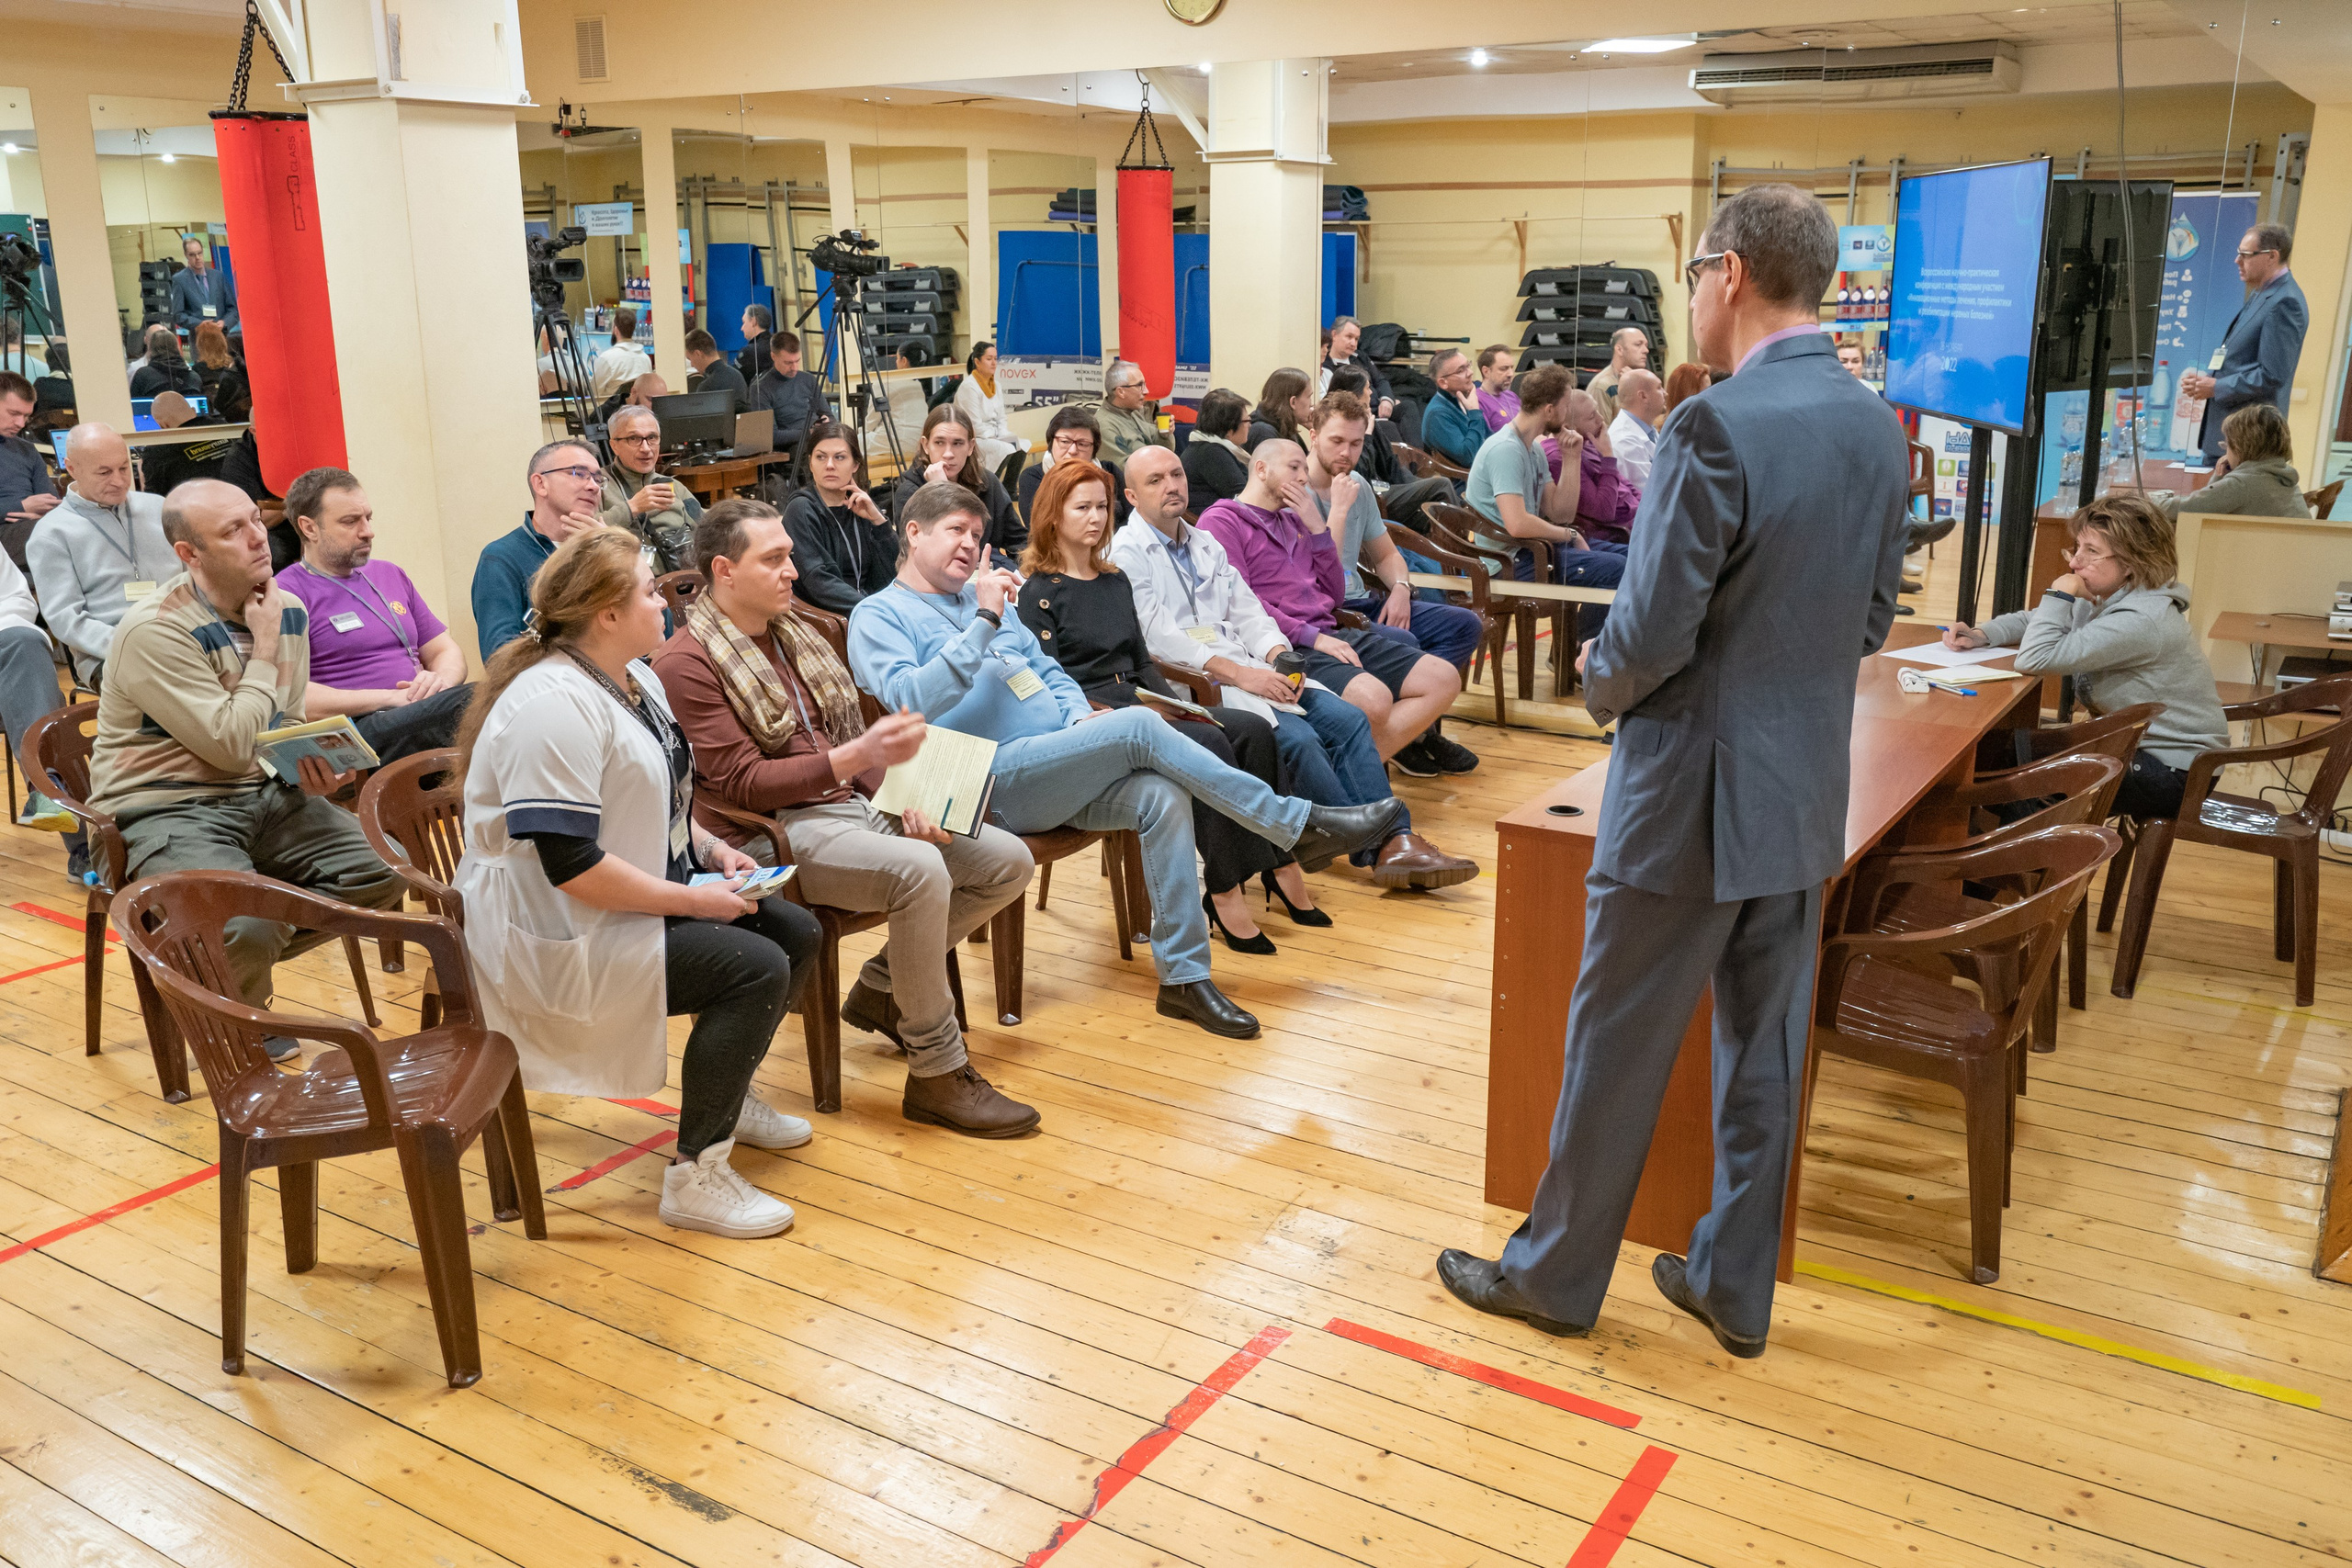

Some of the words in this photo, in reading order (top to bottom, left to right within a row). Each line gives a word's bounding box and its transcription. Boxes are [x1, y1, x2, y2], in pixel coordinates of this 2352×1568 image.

[288, 135, 299, 173] CLASS
[1940, 355, 1958, 372] 2022
[1000, 368, 1036, 379] novex
